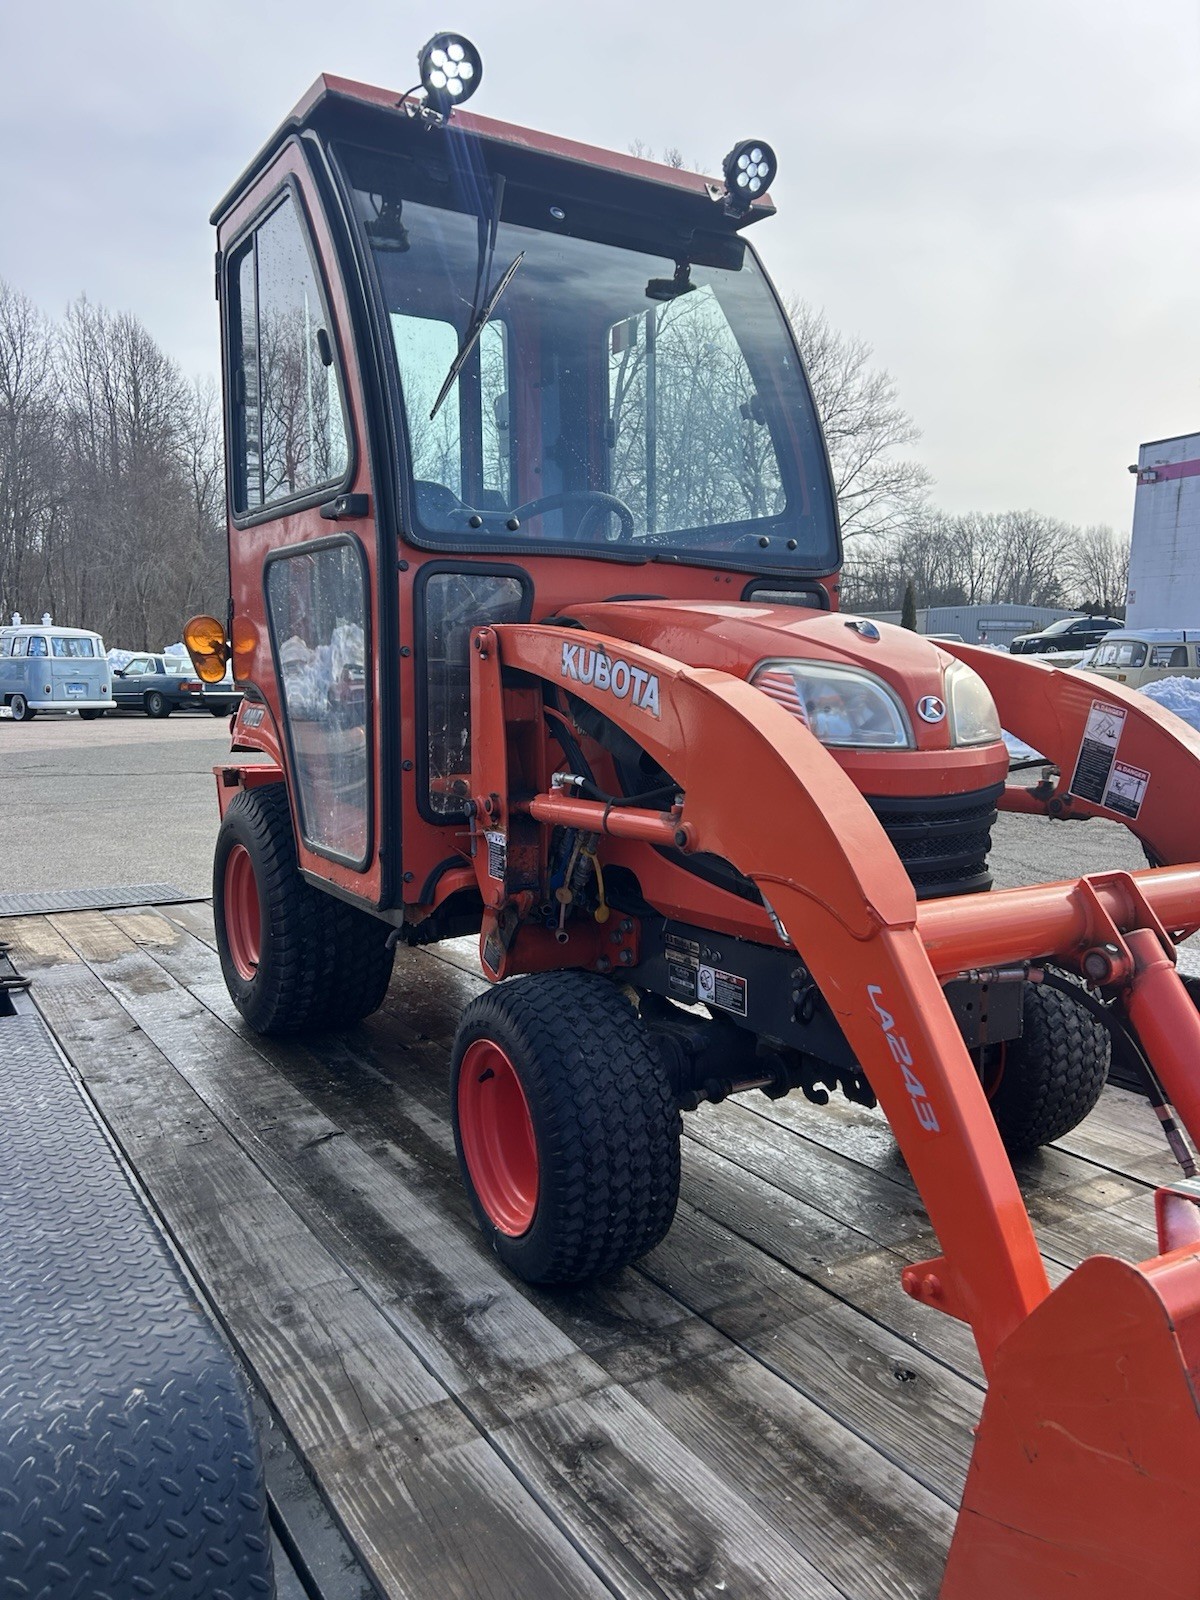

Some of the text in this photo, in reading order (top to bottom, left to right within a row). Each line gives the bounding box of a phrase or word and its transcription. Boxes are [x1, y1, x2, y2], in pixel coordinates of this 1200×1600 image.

[561, 642, 660, 717] KUBOTA
[1101, 702, 1124, 717] DANGER
[1122, 765, 1147, 779] DANGER
[867, 984, 940, 1132] LA243
